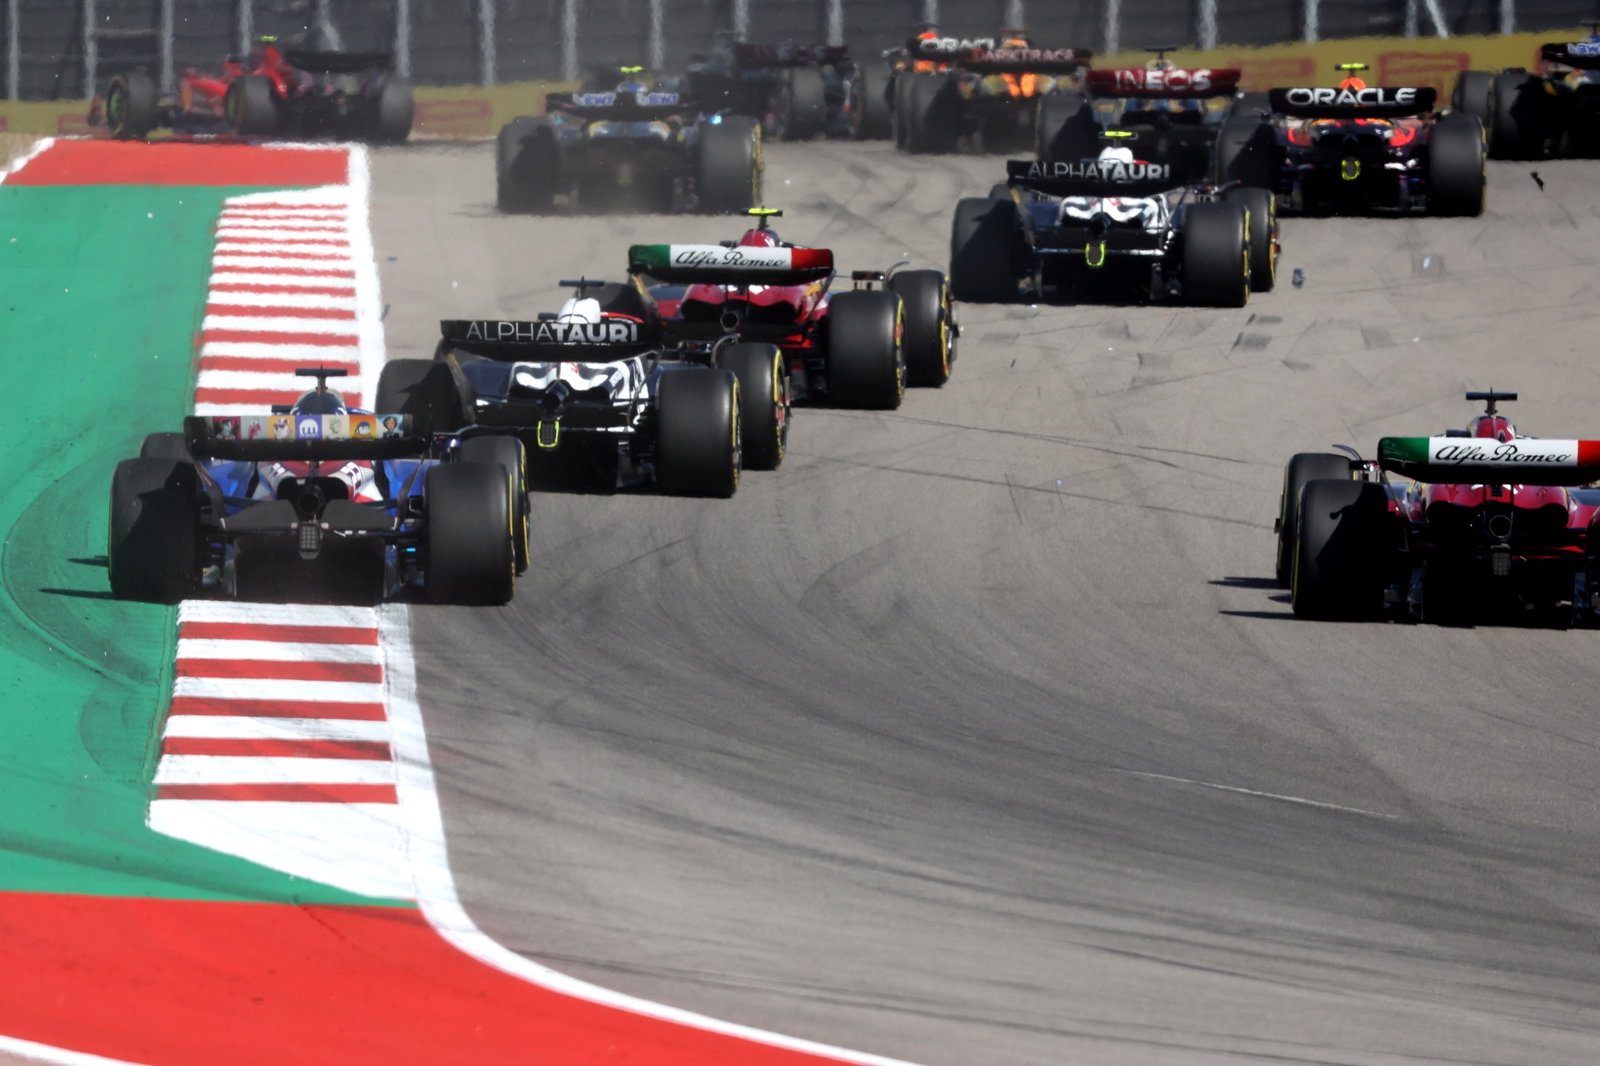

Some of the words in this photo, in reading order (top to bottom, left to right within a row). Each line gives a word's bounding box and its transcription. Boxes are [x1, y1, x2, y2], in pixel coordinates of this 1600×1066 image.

[1114, 69, 1212, 91] INEOS
[1286, 88, 1417, 105] ORACLE
[1027, 161, 1171, 180] ALPHATAURI
[675, 251, 719, 269] Alfa
[721, 251, 785, 267] Romeo
[466, 321, 638, 343] ALPHATAURI
[1435, 445, 1490, 465] Alfa
[1491, 444, 1571, 463] Romeo
